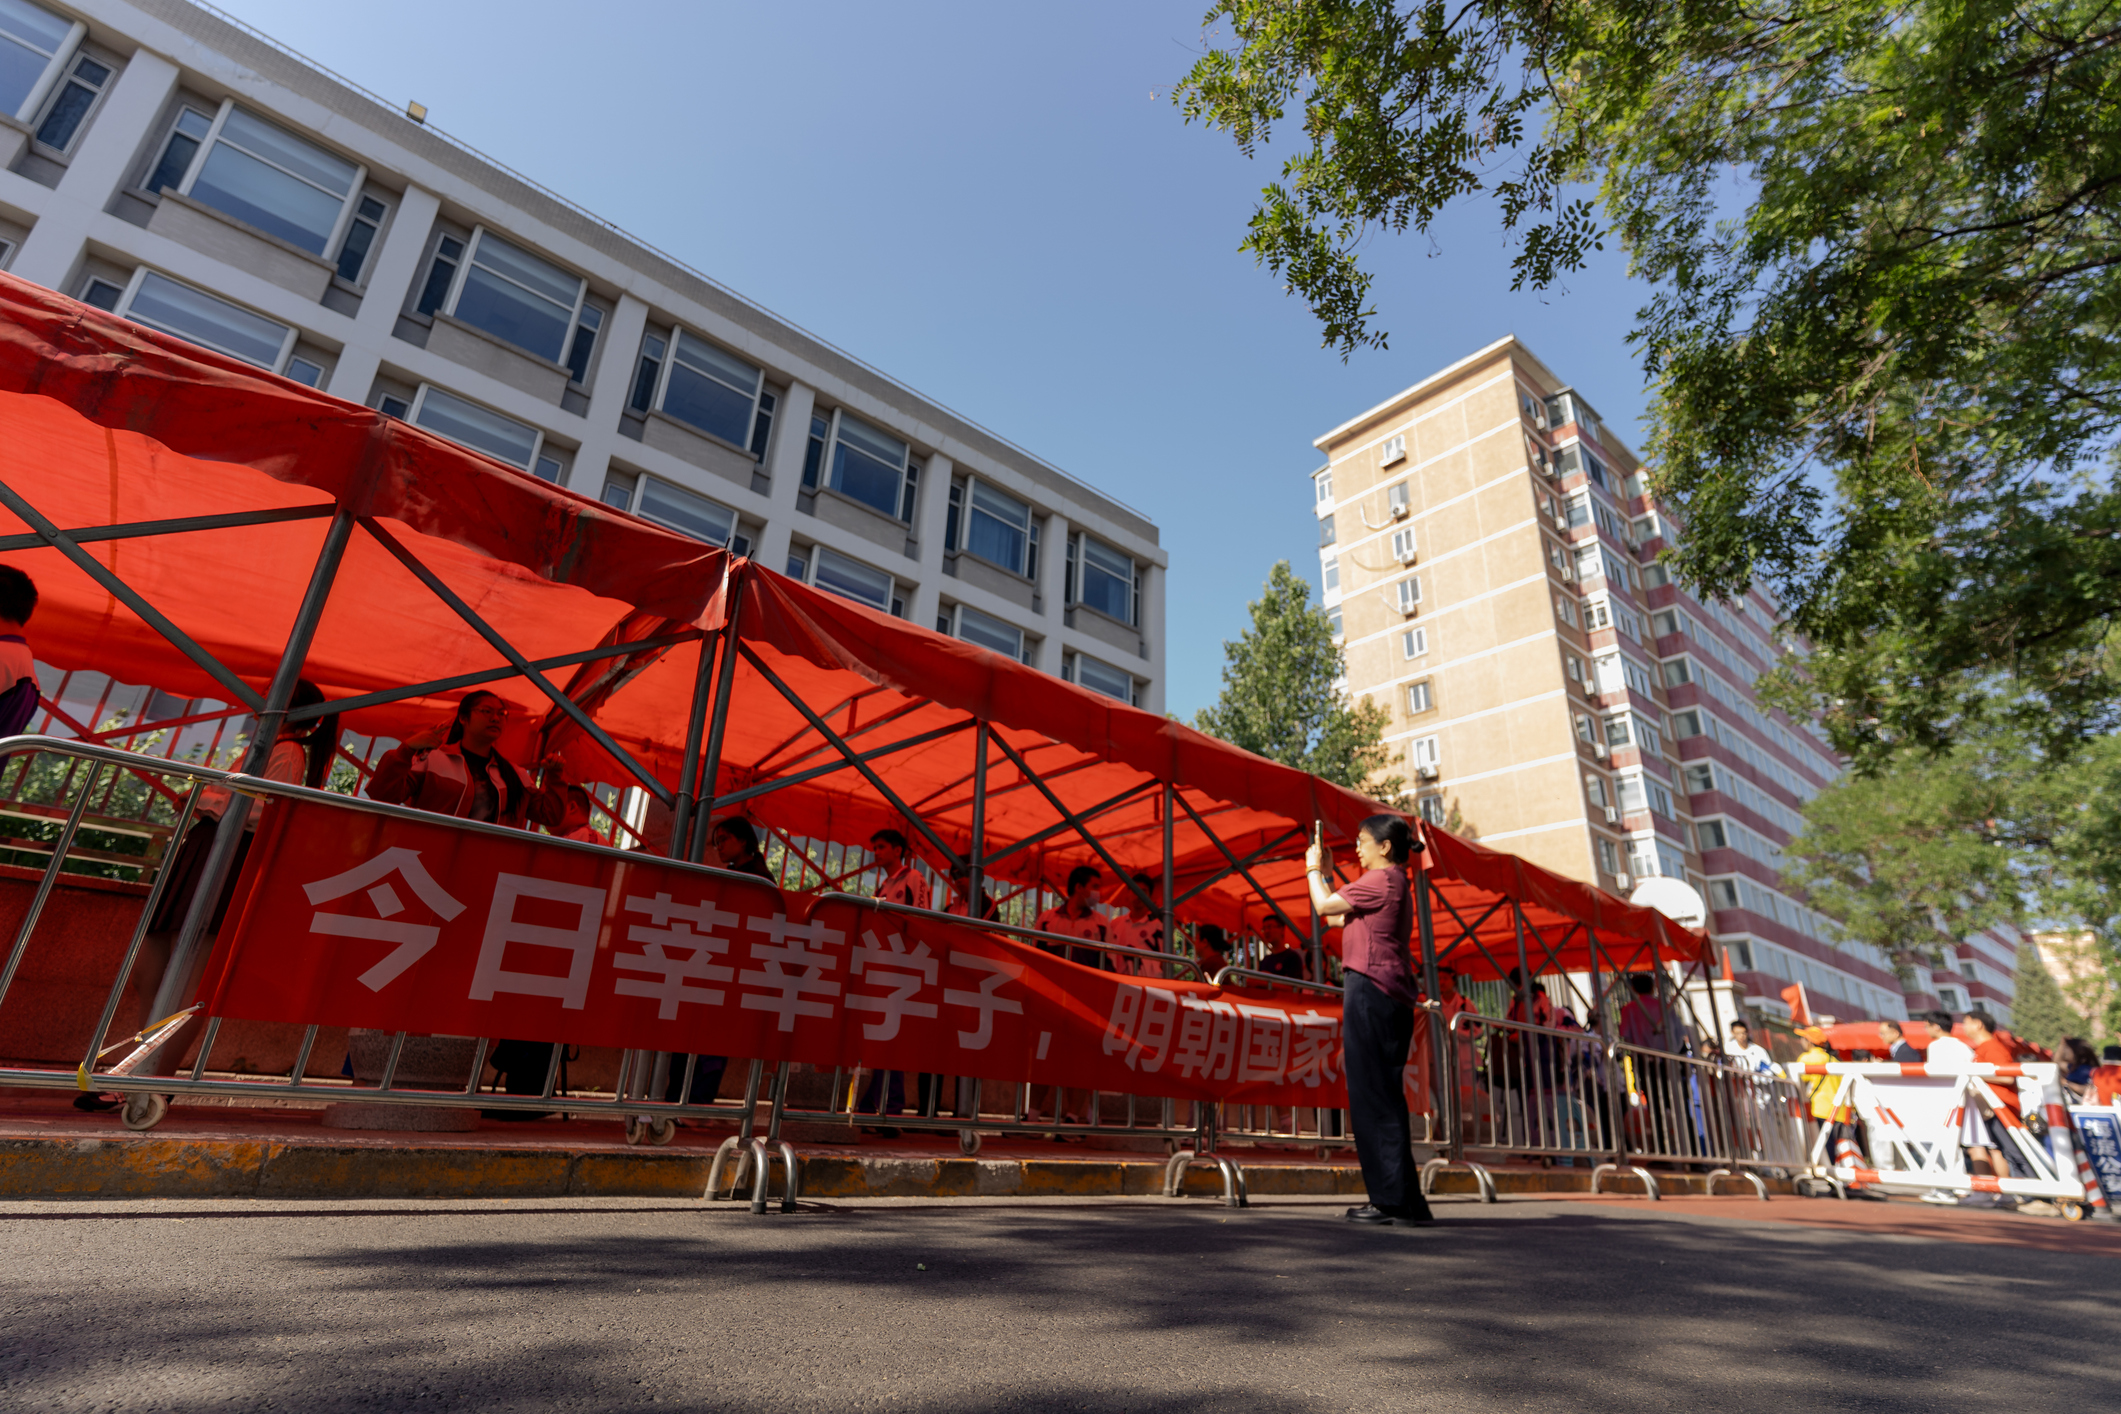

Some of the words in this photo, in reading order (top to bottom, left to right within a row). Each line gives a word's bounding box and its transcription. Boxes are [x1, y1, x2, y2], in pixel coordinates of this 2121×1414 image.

[302, 846, 1419, 1094] 今日莘莘学子，明朝国家
